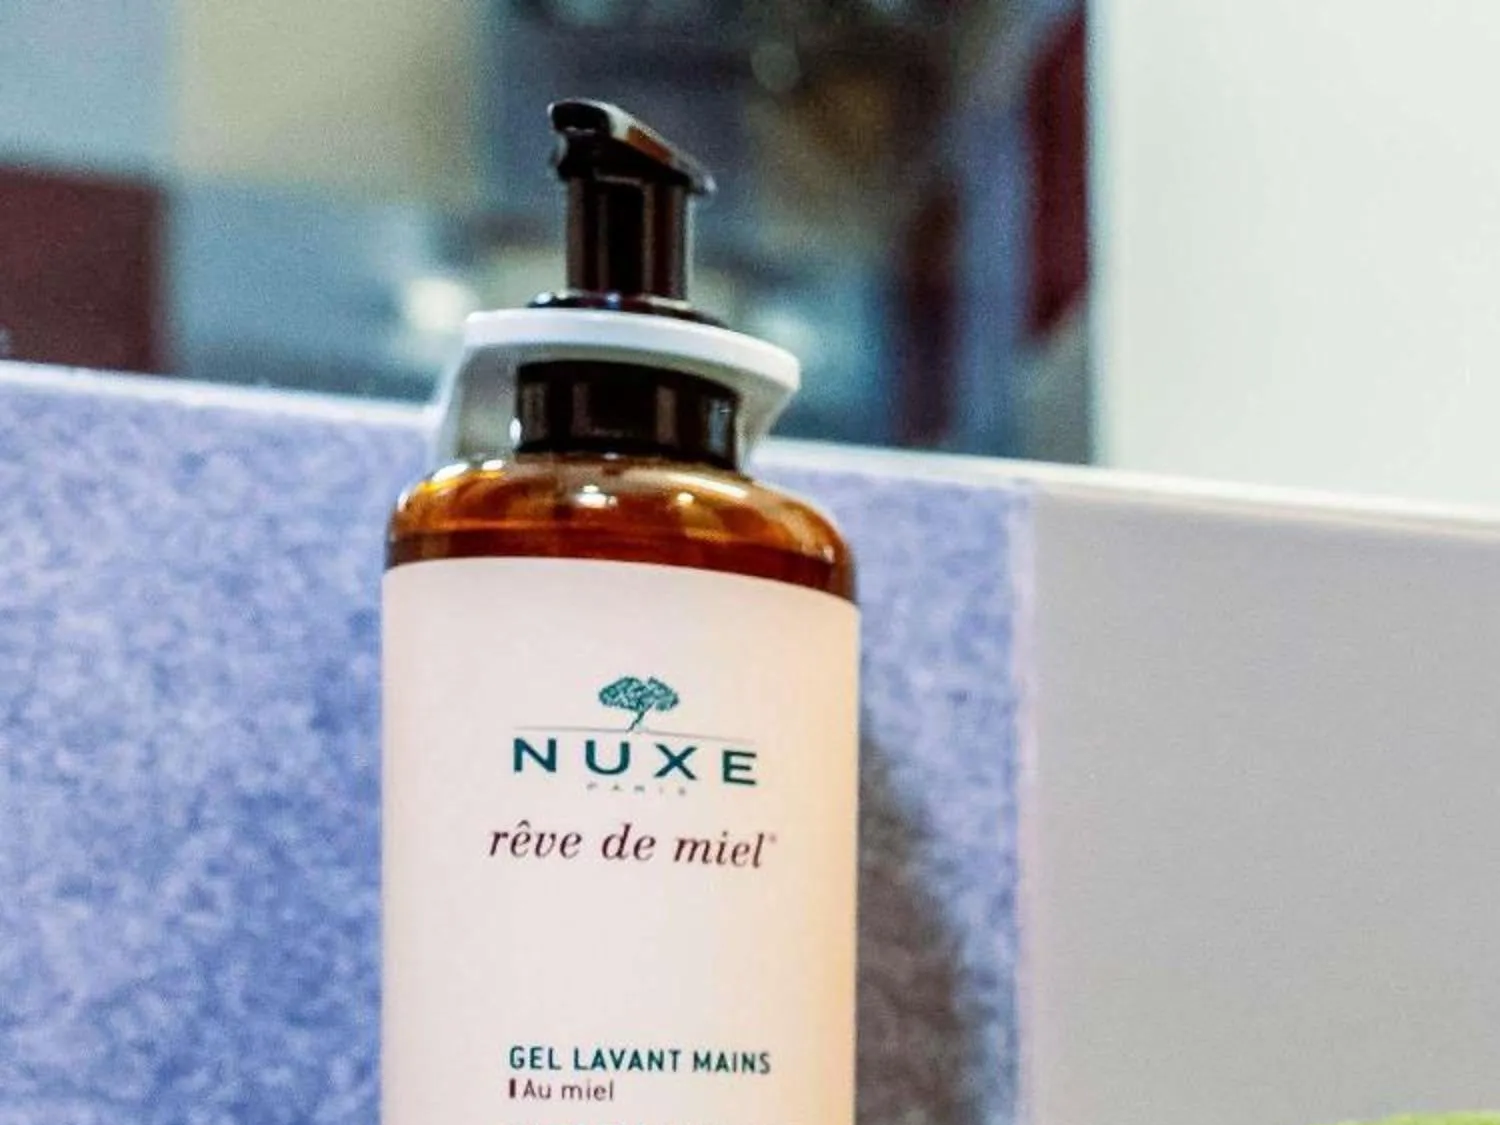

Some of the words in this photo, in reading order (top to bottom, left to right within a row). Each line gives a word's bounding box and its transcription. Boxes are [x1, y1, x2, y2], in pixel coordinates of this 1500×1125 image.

[513, 738, 758, 786] NUXE
[586, 782, 687, 797] PARIS
[488, 819, 582, 860] rêve
[601, 823, 656, 863] de
[508, 1046, 562, 1071] GEL
[573, 1048, 681, 1073] LAVANT
[692, 1050, 772, 1075] MAINS
[522, 1079, 552, 1100] Au
[560, 1080, 615, 1101] miel
